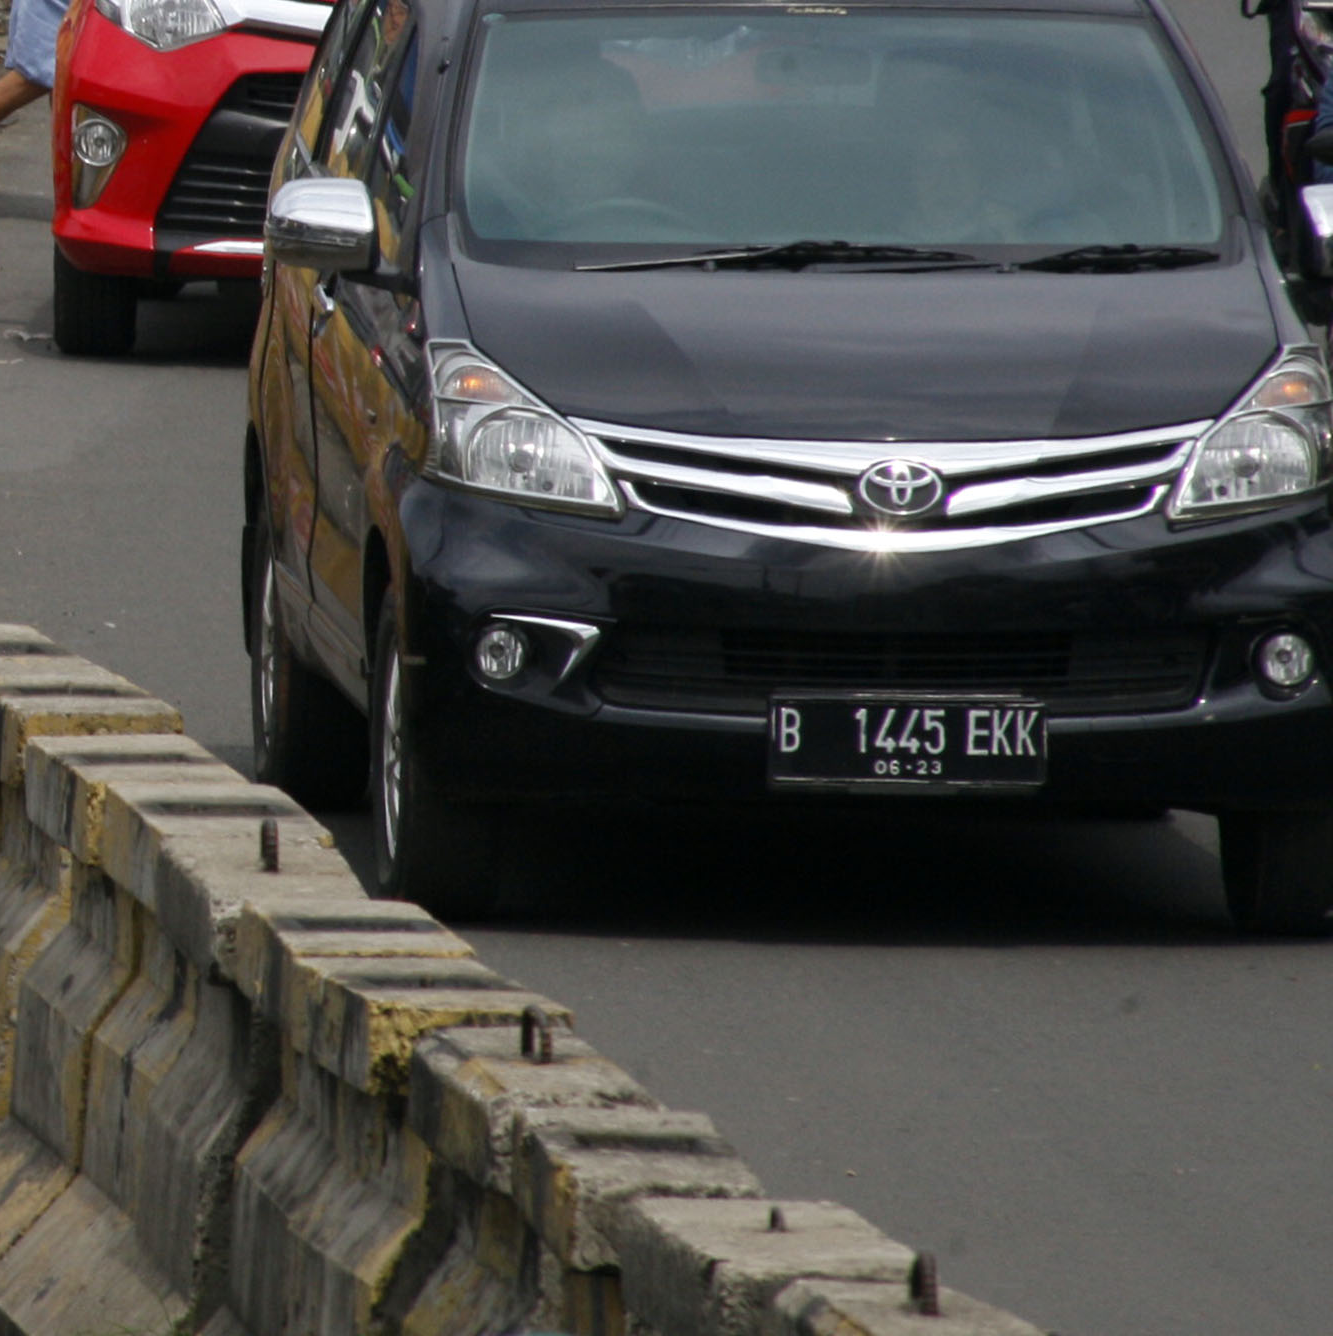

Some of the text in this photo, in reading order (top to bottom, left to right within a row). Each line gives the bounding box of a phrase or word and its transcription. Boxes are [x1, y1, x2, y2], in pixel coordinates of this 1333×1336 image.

[779, 707, 1039, 756] B 1445 EKK
